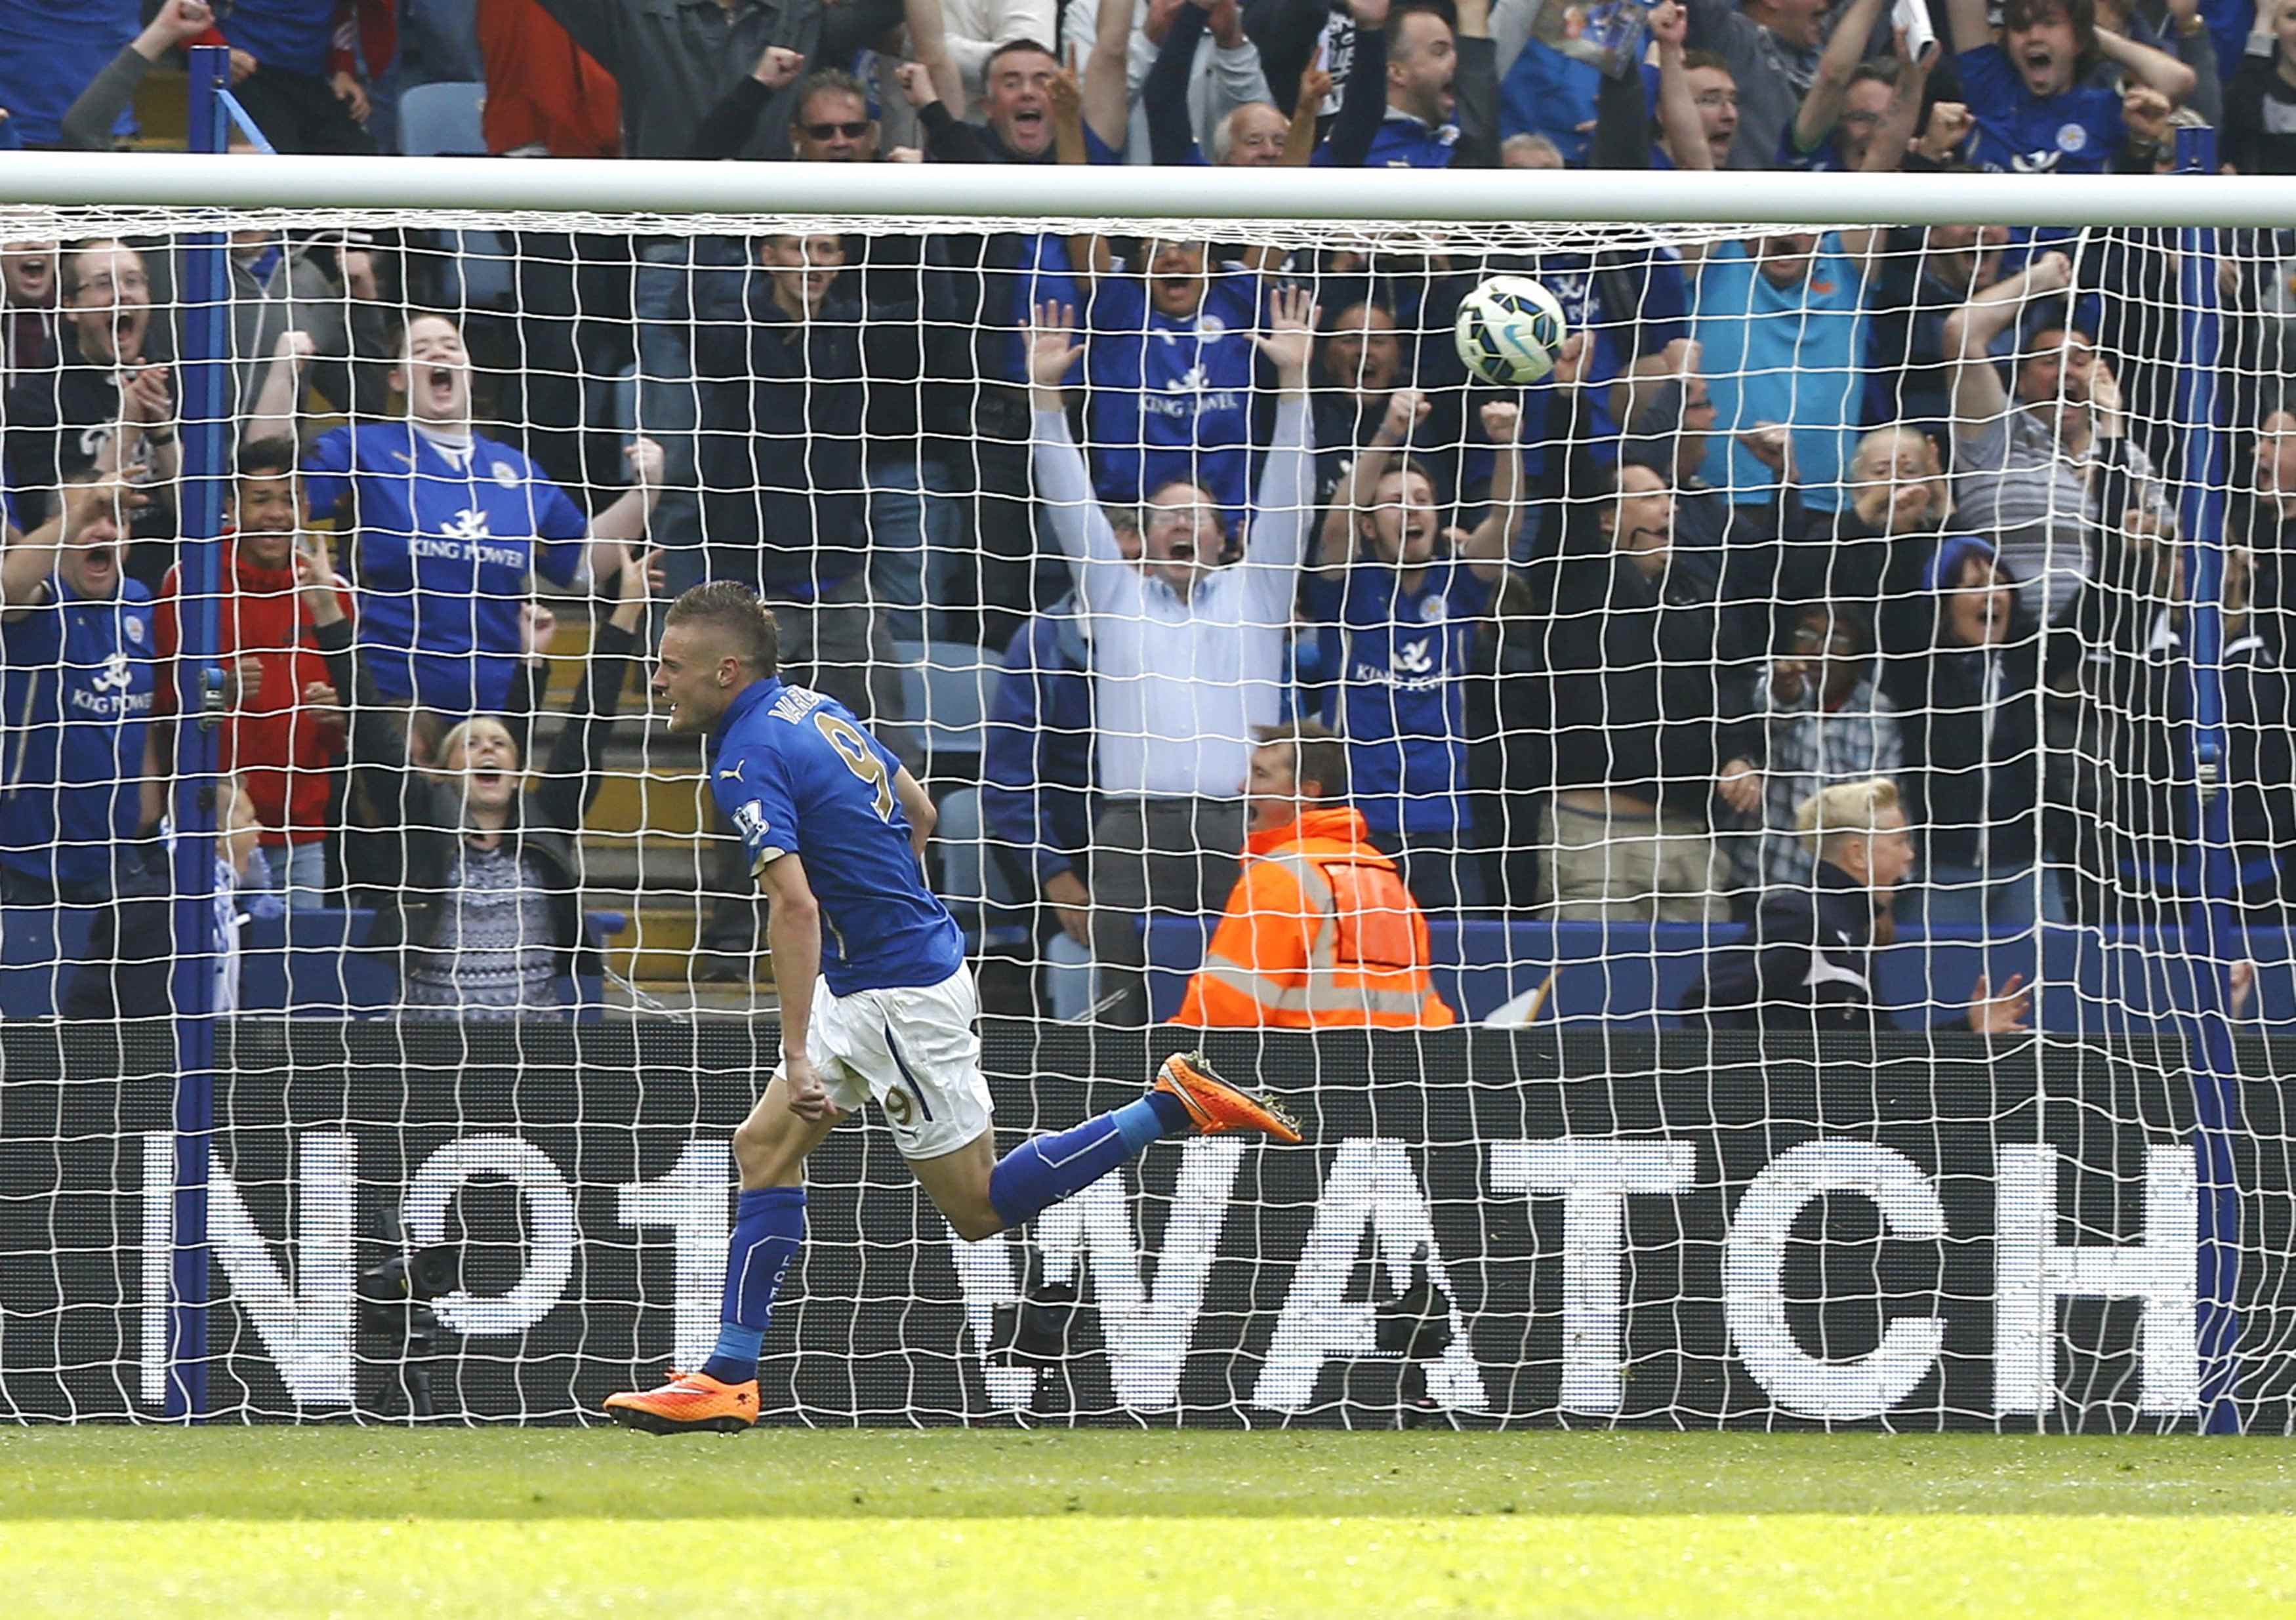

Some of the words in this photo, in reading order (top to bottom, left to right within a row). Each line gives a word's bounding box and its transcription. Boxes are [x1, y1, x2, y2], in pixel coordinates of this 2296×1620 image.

[407, 539, 459, 559] KING
[110, 692, 154, 712] POWE
[813, 711, 894, 824] 9
[886, 1085, 911, 1125] 9
[941, 1136, 2198, 1416] WATCH
